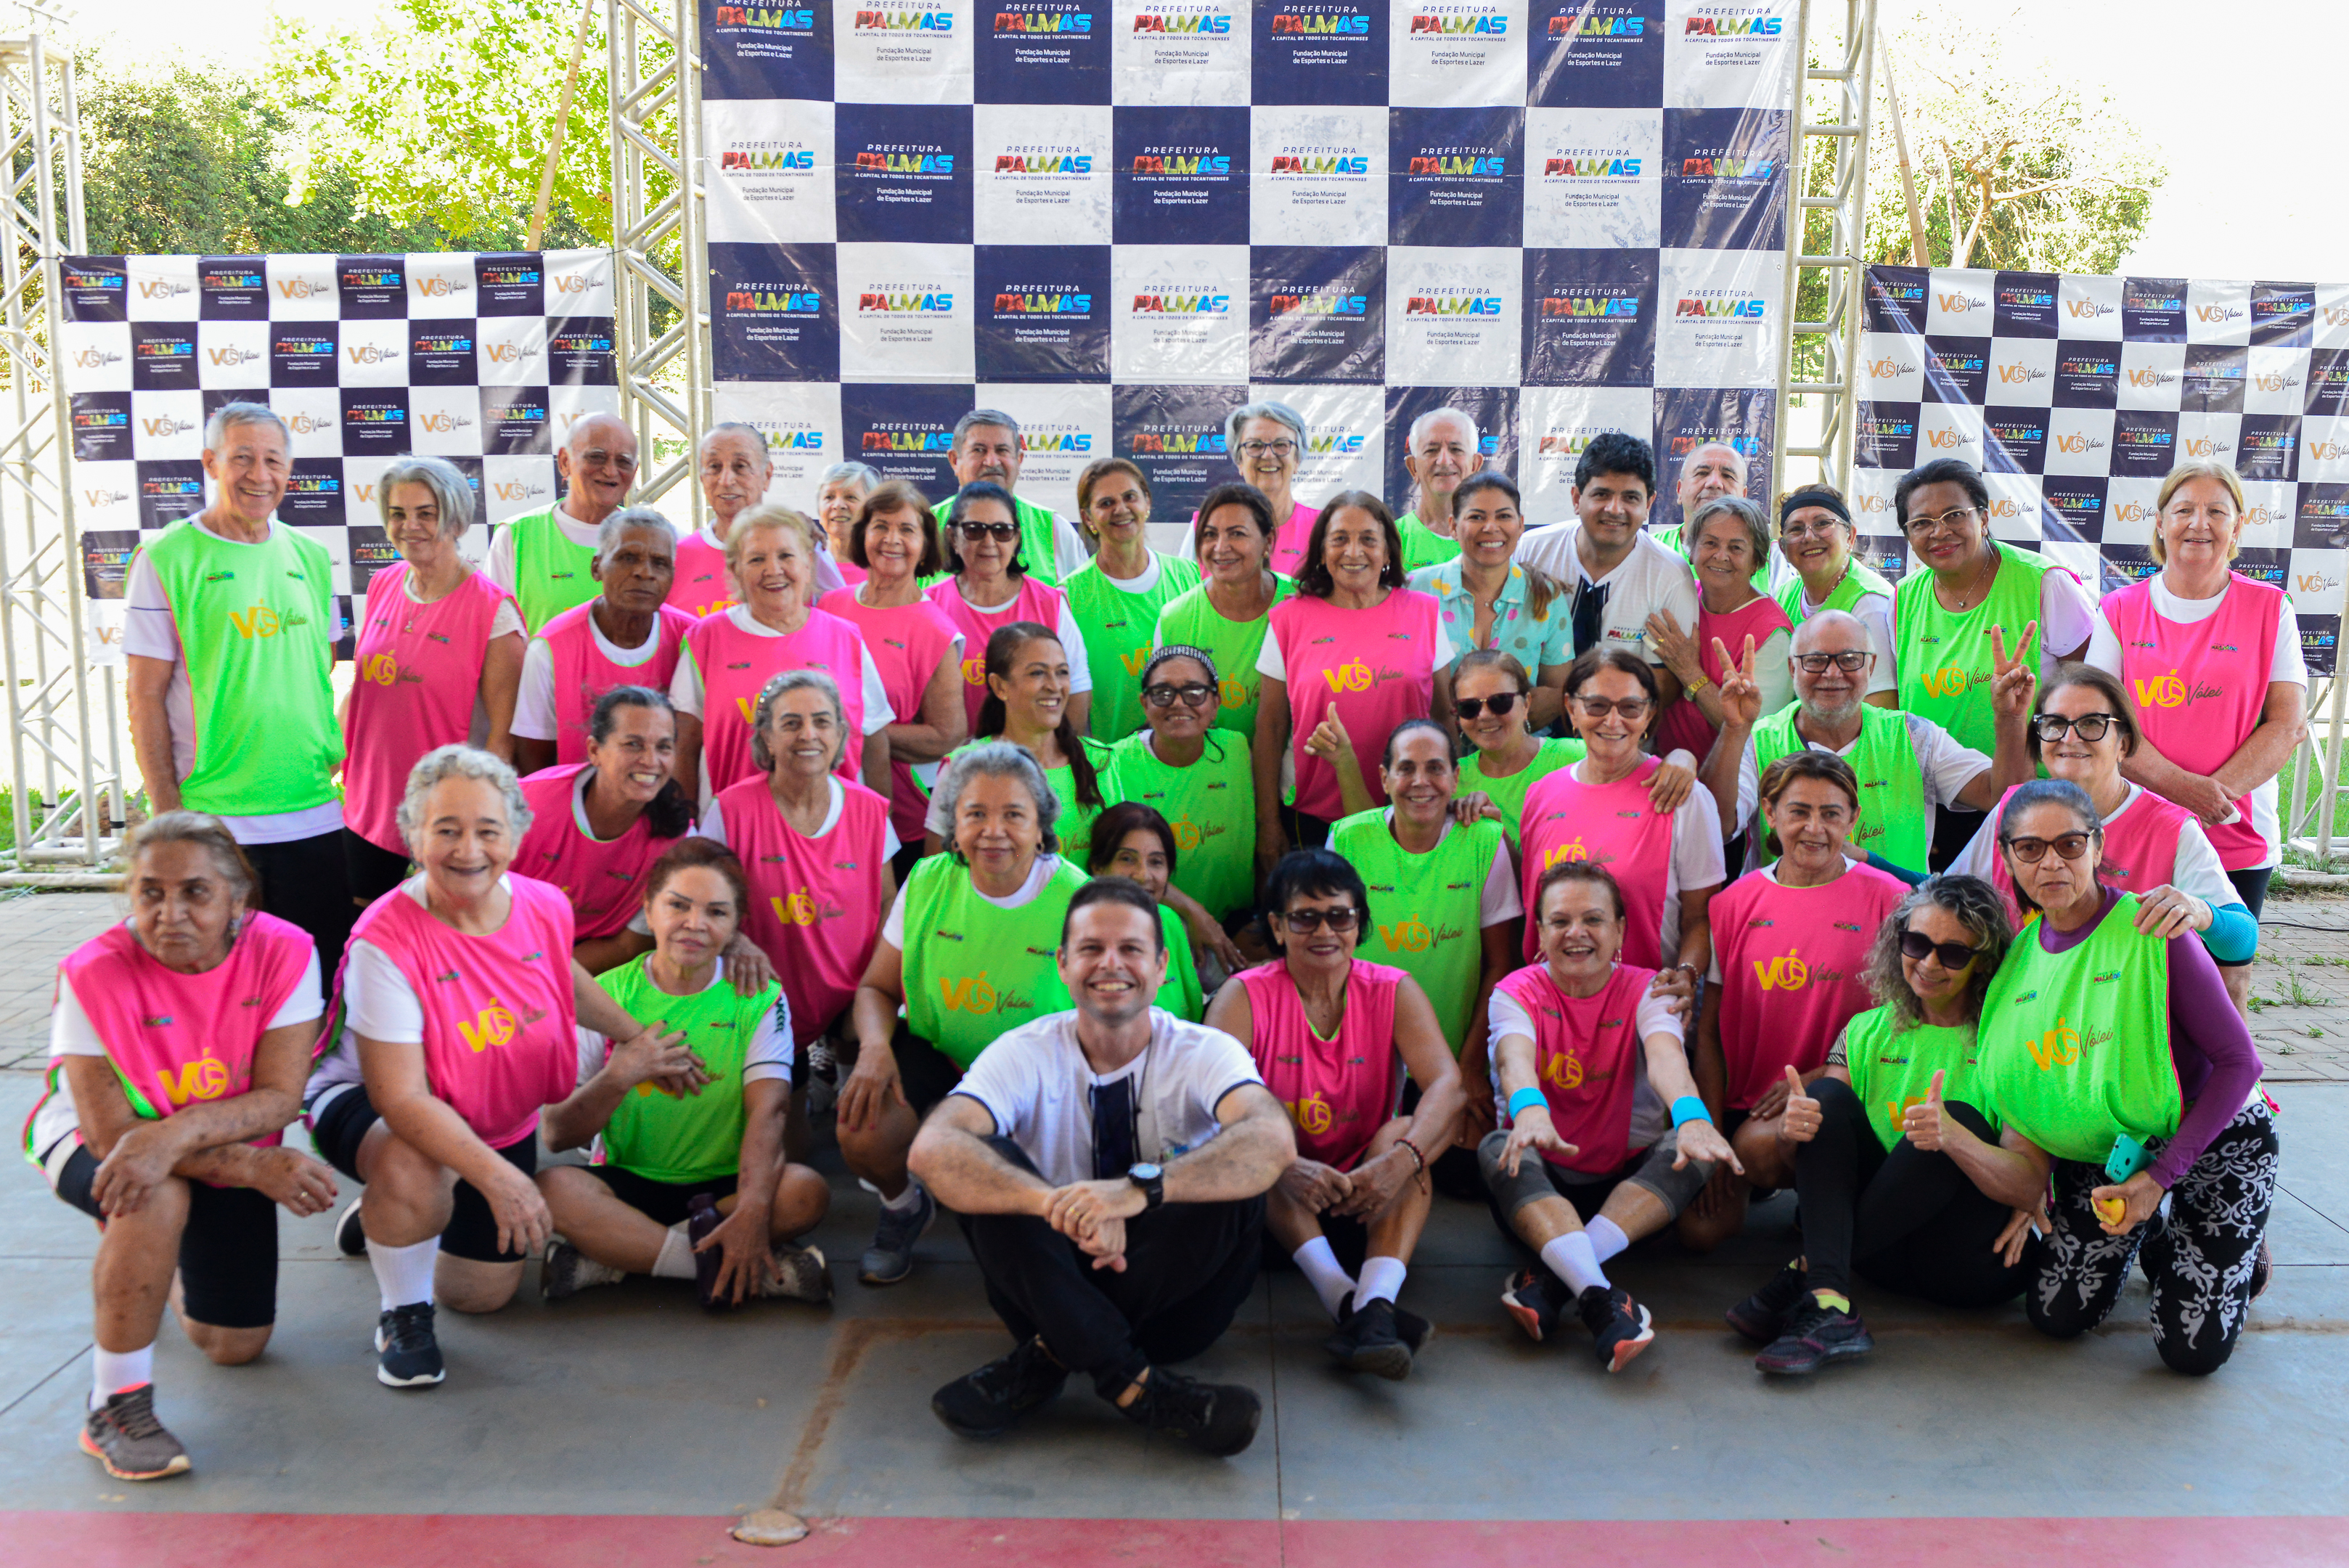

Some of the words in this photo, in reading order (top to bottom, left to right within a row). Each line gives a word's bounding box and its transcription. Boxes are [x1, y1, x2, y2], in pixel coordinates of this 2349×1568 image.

[866, 1, 941, 9] PREFEITURA
[1697, 7, 1771, 16] PREFEITURA
[715, 7, 814, 28] PALMAS
[854, 10, 953, 30] PALMAS
[994, 13, 1092, 32] PALMAS
[1133, 15, 1231, 33] PALMAS
[1272, 15, 1370, 33] PALMAS
[1410, 15, 1508, 34] PALMAS
[1548, 16, 1644, 35] PALMAS
[1685, 16, 1783, 36] PALMAS
[730, 141, 802, 150] PREFEITURA
[867, 143, 942, 152] PREFEITURA
[719, 150, 814, 171] PALMAS
[855, 152, 954, 173] PALMAS
[994, 155, 1092, 173] PALMAS
[1132, 155, 1230, 174] PALMAS
[1271, 156, 1368, 174] PALMAS
[1409, 156, 1505, 175] PALMAS
[1544, 158, 1641, 176] PALMAS
[343, 274, 401, 285] PALMAS
[482, 272, 539, 283] PALMAS
[724, 292, 820, 311] PALMAS
[857, 293, 953, 311] PALMAS
[994, 293, 1091, 312] PALMAS
[1132, 294, 1229, 313] PALMAS
[1270, 295, 1367, 314] PALMAS
[1406, 297, 1502, 315] PALMAS
[1542, 298, 1638, 316] PALMAS
[1676, 299, 1765, 317] PALMAS
[2000, 293, 2052, 306] PALMAS
[414, 340, 472, 351] PALMAS
[2062, 362, 2115, 375] PALMAS
[2119, 432, 2172, 445] PALMAS
[1966, 666, 1992, 693] Vôle
